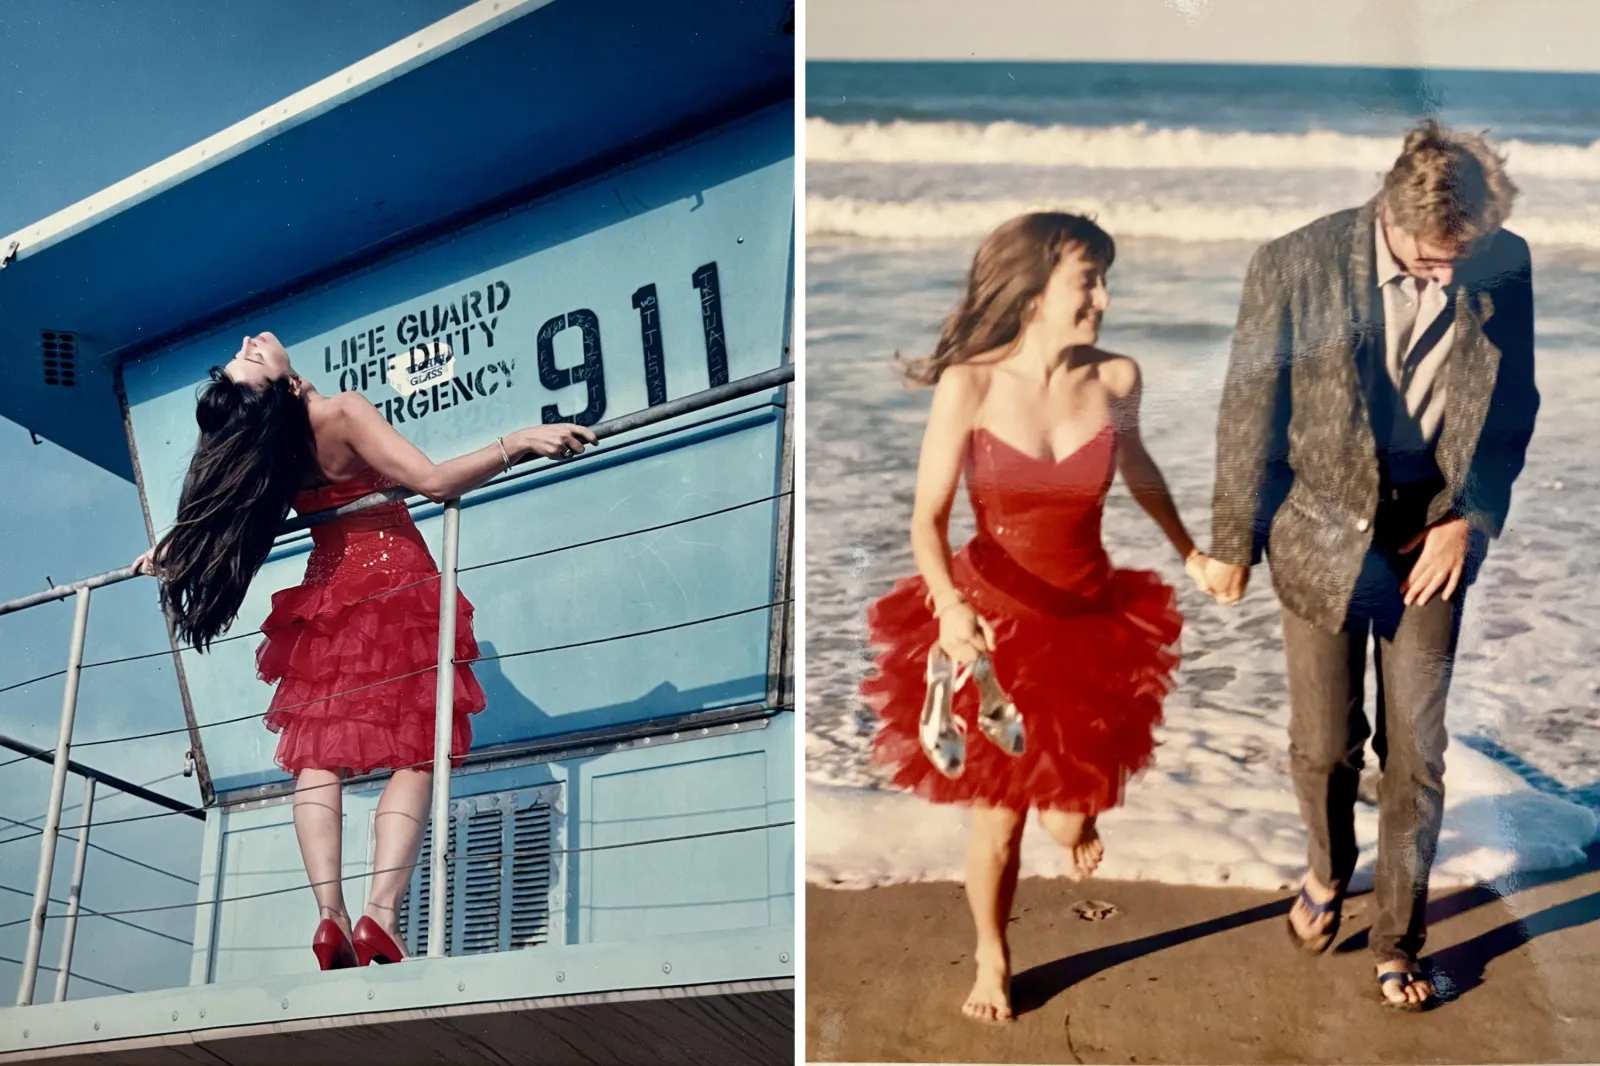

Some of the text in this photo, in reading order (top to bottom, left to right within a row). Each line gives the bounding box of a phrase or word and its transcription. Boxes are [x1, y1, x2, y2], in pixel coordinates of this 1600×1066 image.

[324, 280, 511, 373] LIFE GUARD
[339, 353, 396, 393] OFF
[409, 316, 499, 374] DUTY
[537, 261, 729, 426] 911
[374, 358, 516, 427] RGENCY
[410, 367, 443, 386] GLASS
